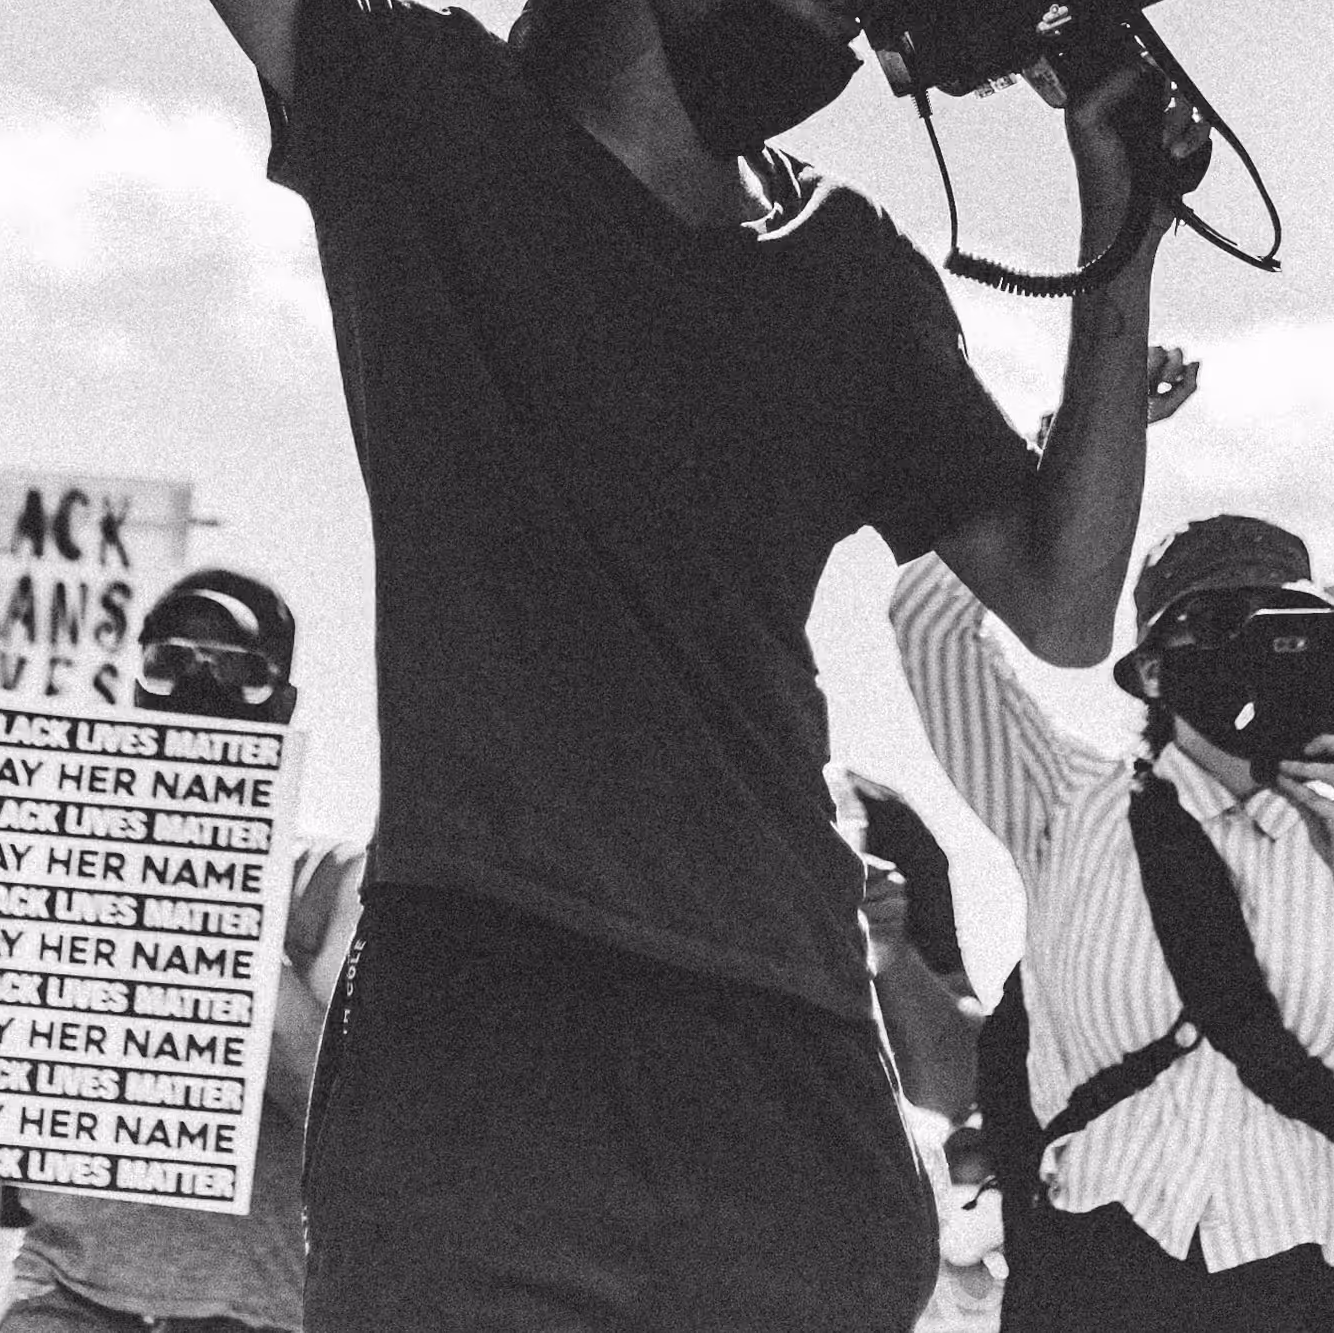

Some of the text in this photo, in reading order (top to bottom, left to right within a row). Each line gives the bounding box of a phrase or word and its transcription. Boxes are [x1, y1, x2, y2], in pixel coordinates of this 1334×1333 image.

[76, 721, 158, 756] LIVES
[164, 727, 282, 766] MATTER
[59, 763, 137, 796] HER
[152, 770, 273, 807] NAME
[65, 806, 148, 840] LIVES
[153, 813, 272, 850] MATTER
[48, 848, 127, 881] HER
[142, 855, 264, 893] NAME
[54, 892, 138, 927] LIVES
[143, 899, 262, 937] MATTER
[39, 934, 117, 968] HER
[132, 941, 255, 980] NAME
[347, 939, 366, 997] COLE
[47, 977, 129, 1013] LIVES
[134, 984, 253, 1023] MATTER
[29, 1020, 108, 1054] HER
[123, 1028, 245, 1066] NAME
[36, 1064, 119, 1100] LIVES
[125, 1072, 244, 1111] MATTER
[20, 1106, 99, 1141] HER
[115, 1115, 236, 1153] NAME
[27, 1150, 111, 1187] LIVES
[116, 1159, 235, 1198] MATTER
